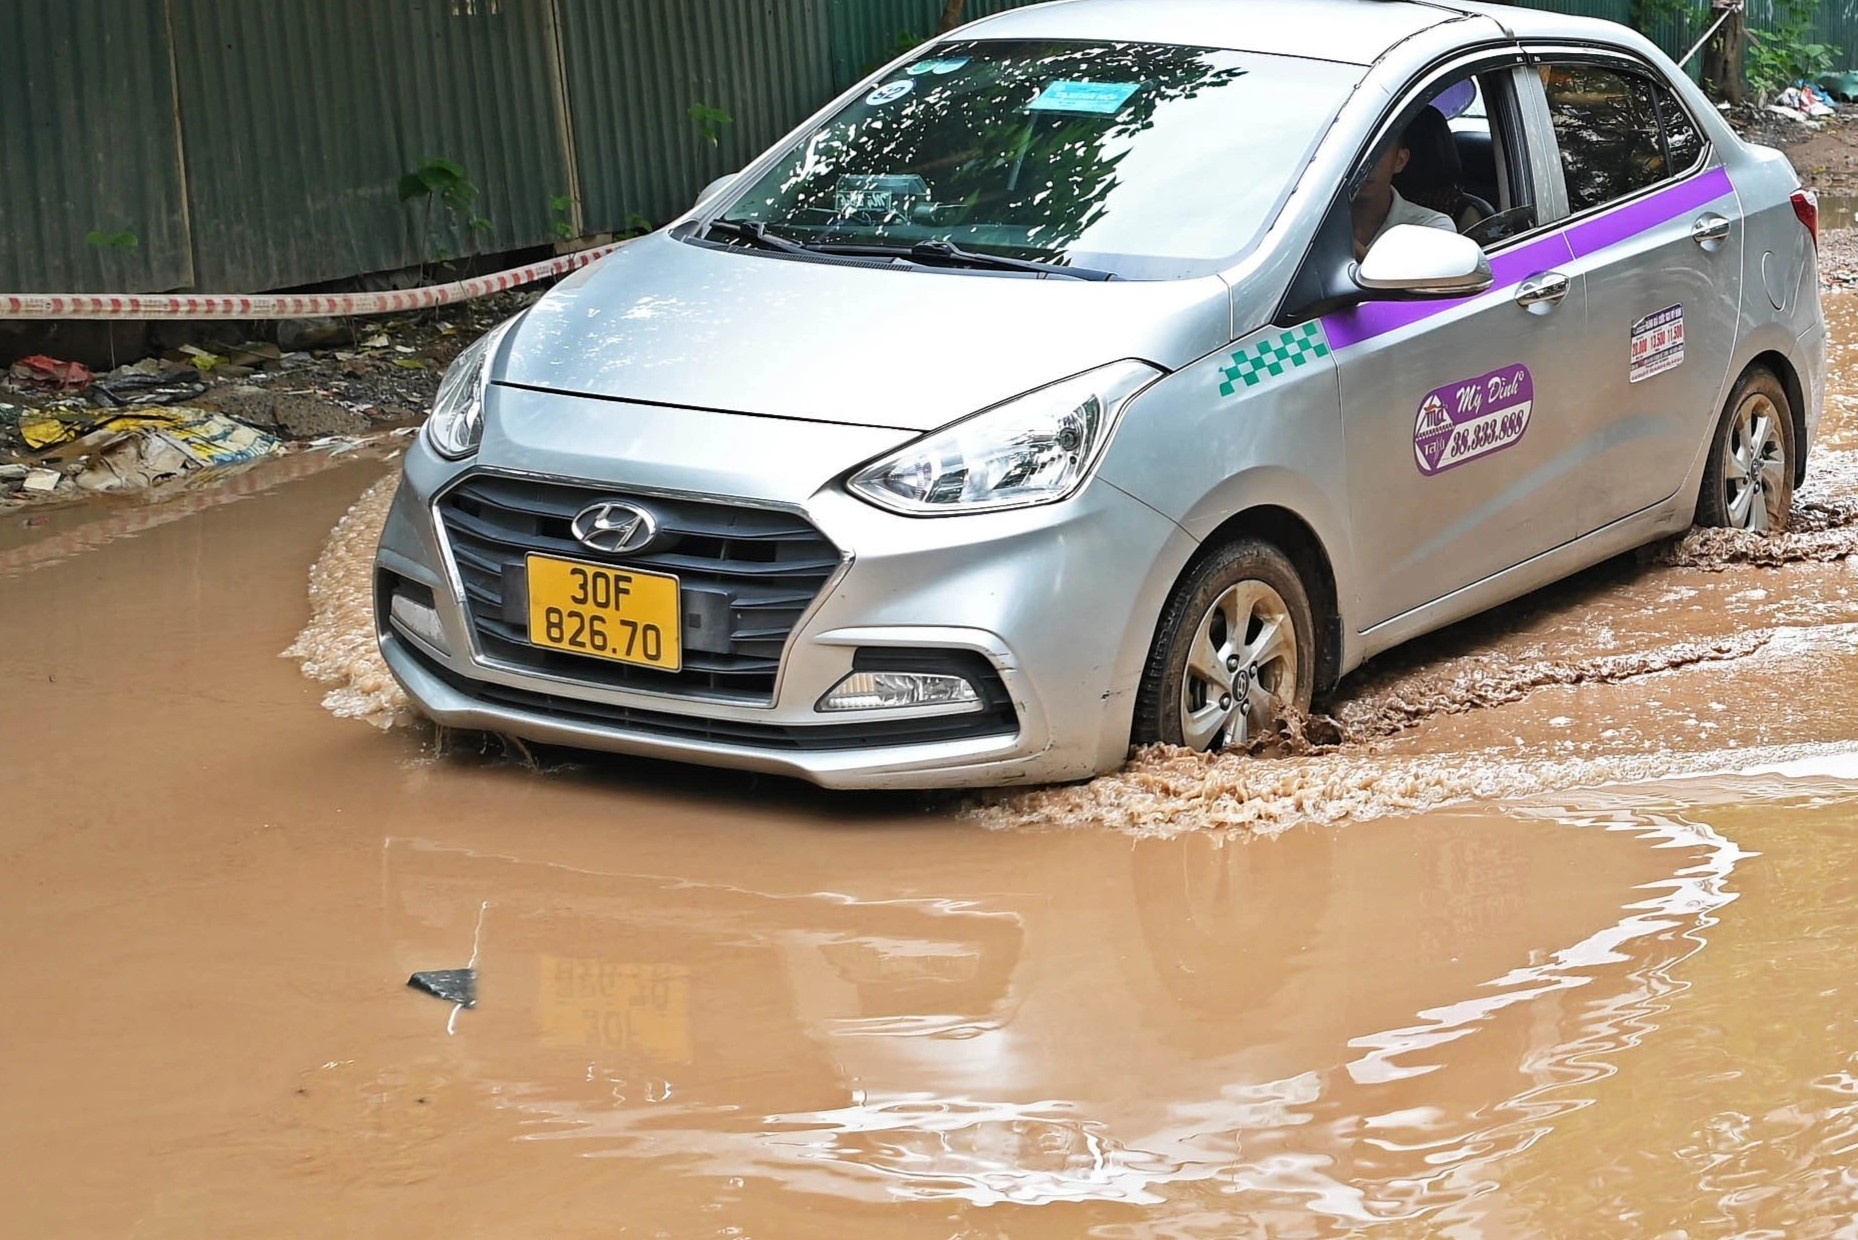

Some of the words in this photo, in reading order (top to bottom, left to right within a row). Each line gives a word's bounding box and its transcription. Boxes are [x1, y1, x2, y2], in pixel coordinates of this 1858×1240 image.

[1488, 370, 1519, 403] Đình
[1450, 409, 1525, 458] 38.333.888
[569, 567, 633, 612] 30F
[544, 606, 662, 662] 826.70
